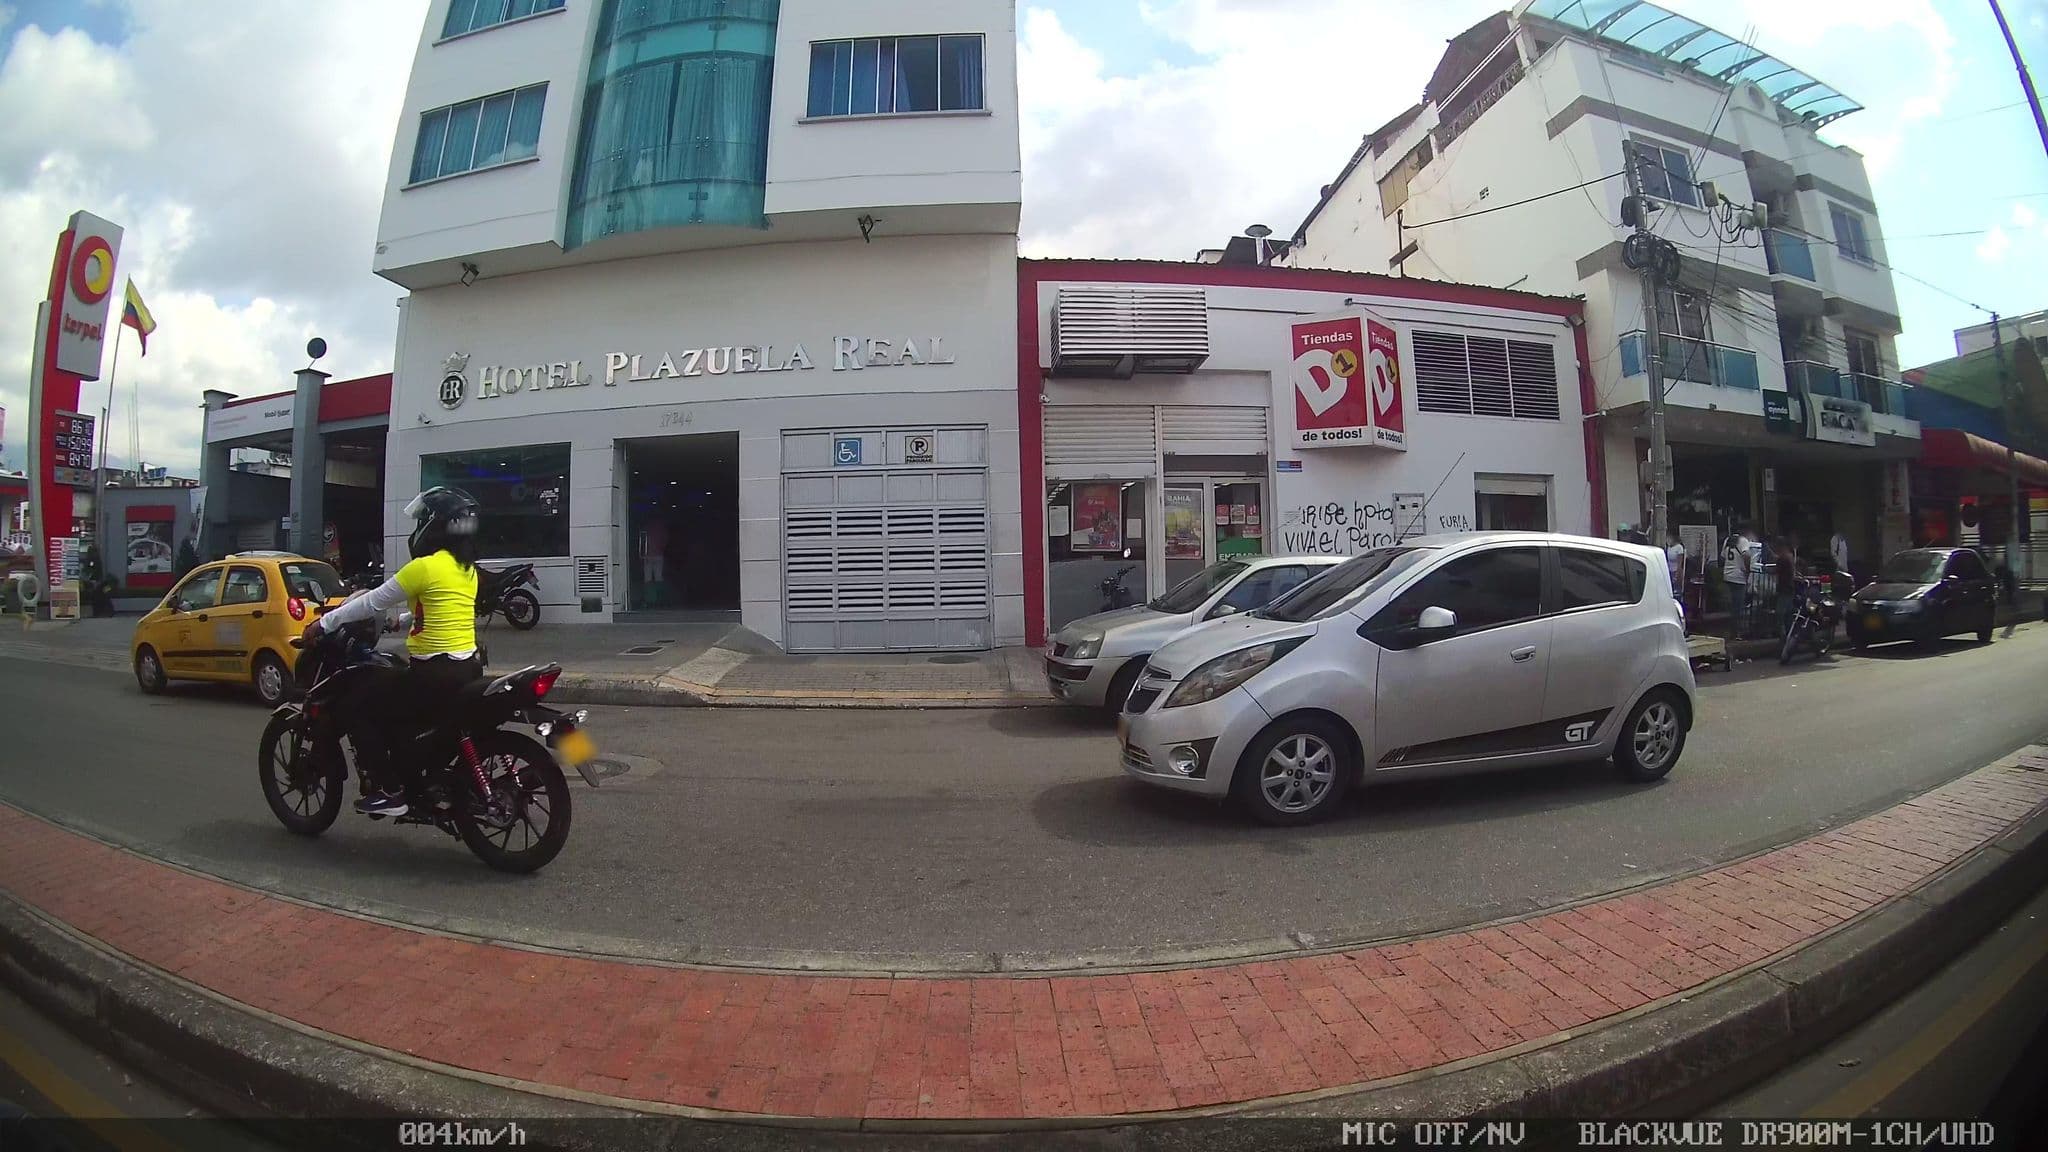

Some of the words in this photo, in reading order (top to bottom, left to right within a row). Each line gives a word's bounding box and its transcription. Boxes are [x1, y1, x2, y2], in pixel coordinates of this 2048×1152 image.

[1301, 331, 1353, 346] Tiendas
[1371, 331, 1394, 351] Tiendas
[477, 361, 593, 399] HOTEL
[604, 344, 814, 387] PLAZUELA
[833, 336, 955, 371] REAL
[1302, 431, 1318, 442] de
[1321, 428, 1362, 441] todos!
[1376, 429, 1385, 440] de
[1565, 721, 1595, 742] GT
